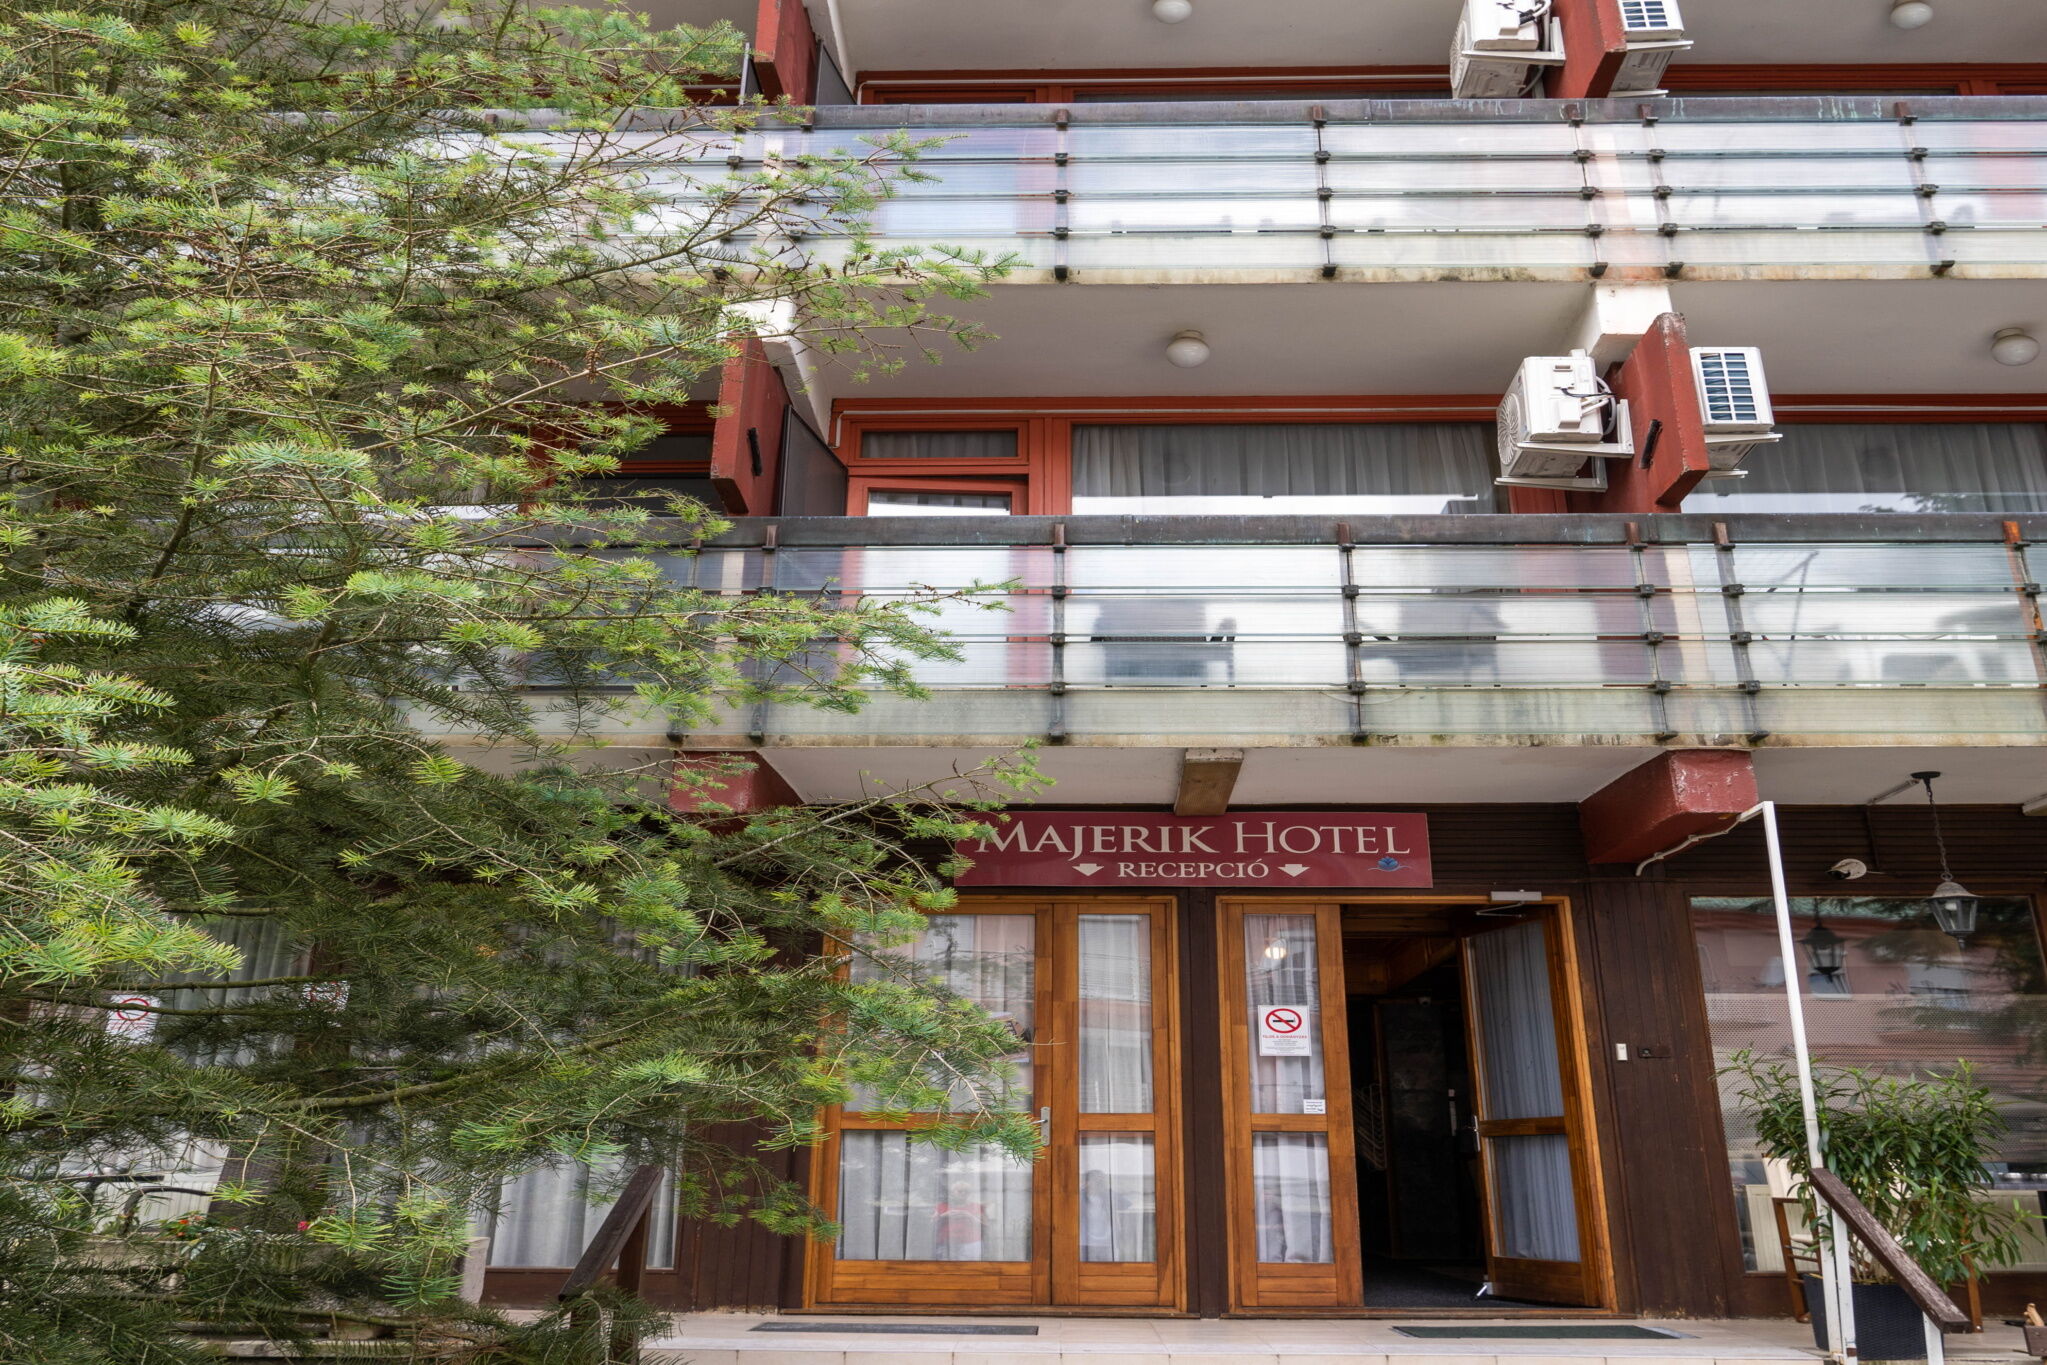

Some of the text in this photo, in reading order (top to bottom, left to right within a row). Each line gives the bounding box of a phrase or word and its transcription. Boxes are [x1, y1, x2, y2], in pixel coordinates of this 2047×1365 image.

[975, 820, 1410, 861] MAJERIK HOTEL
[1117, 858, 1269, 878] RECEPCIÓ
